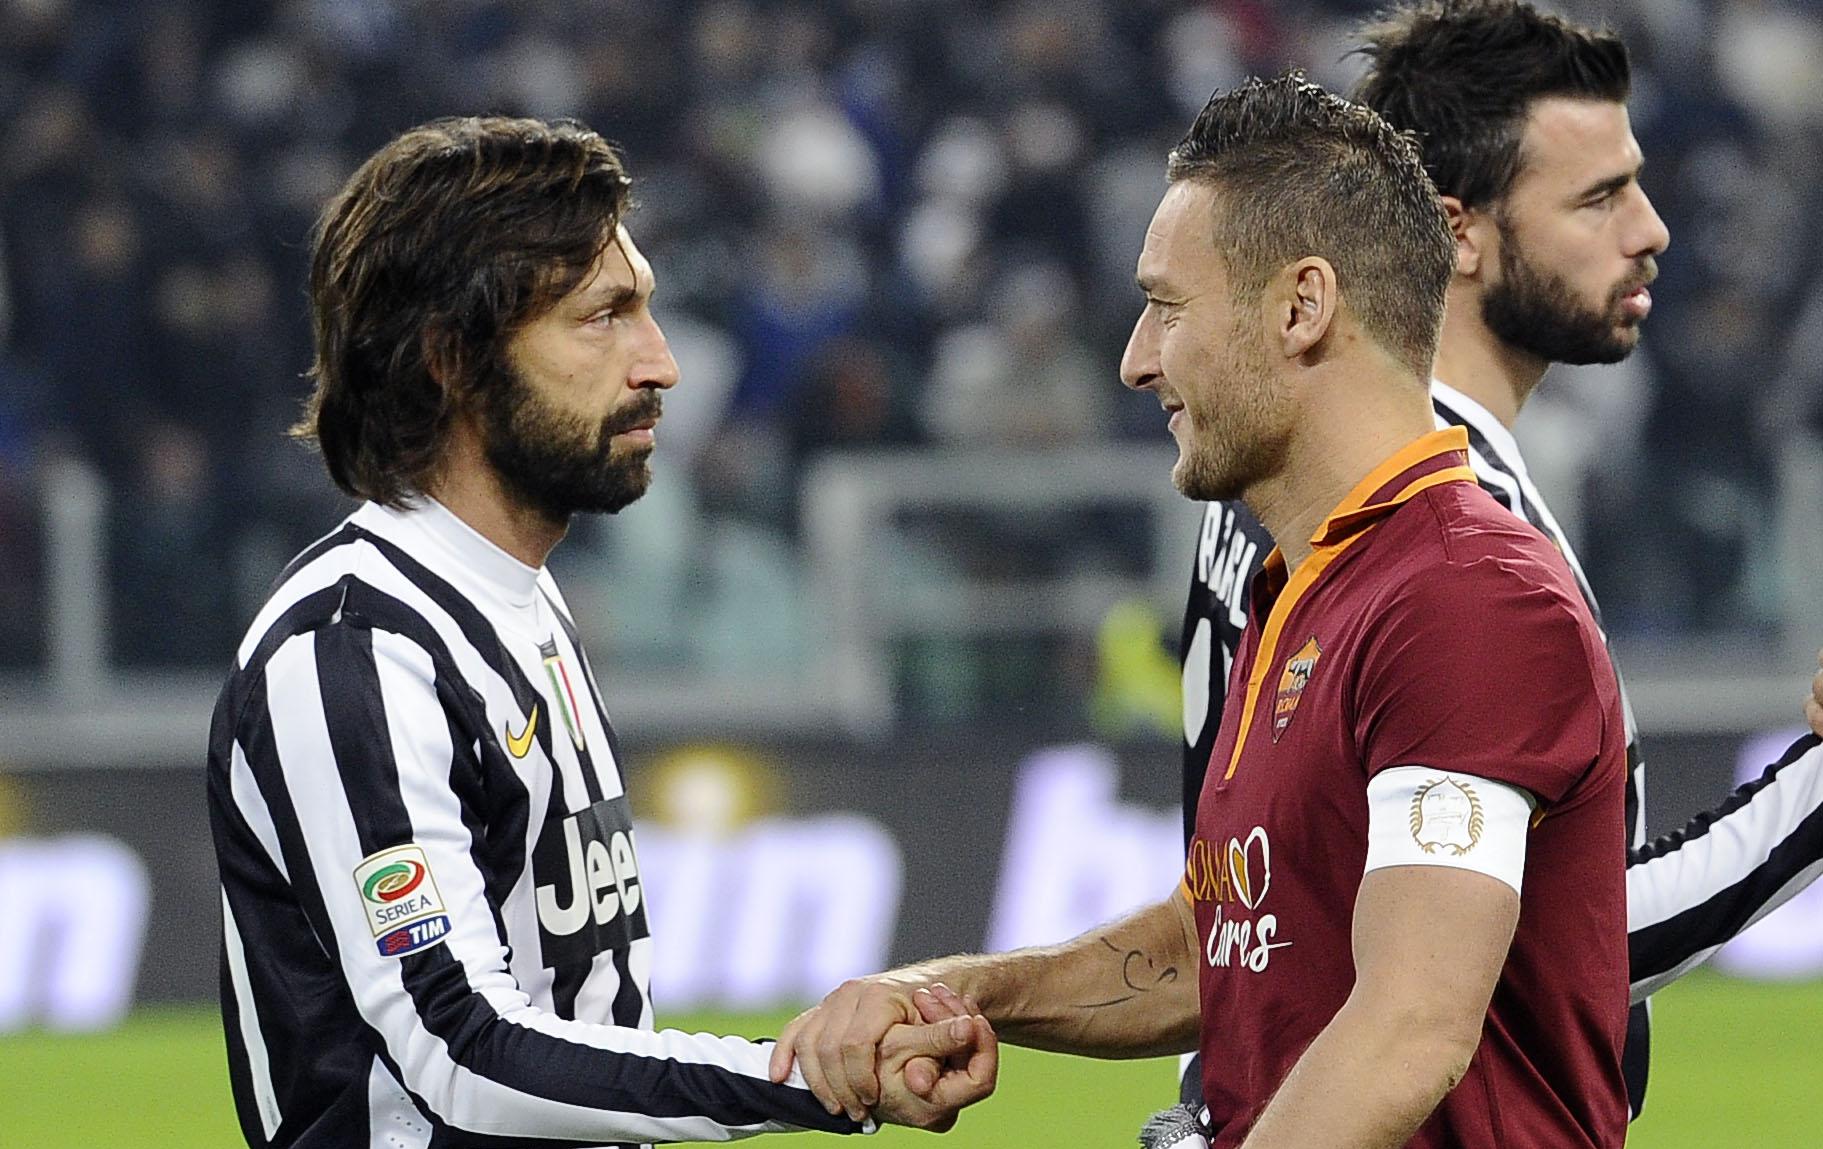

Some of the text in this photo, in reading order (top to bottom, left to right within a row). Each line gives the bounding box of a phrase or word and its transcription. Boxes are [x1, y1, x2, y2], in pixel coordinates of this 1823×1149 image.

[536, 816, 645, 936] Jee
[375, 894, 433, 925] SERIE A
[408, 917, 446, 945] TIM
[1206, 904, 1293, 973] Cares
